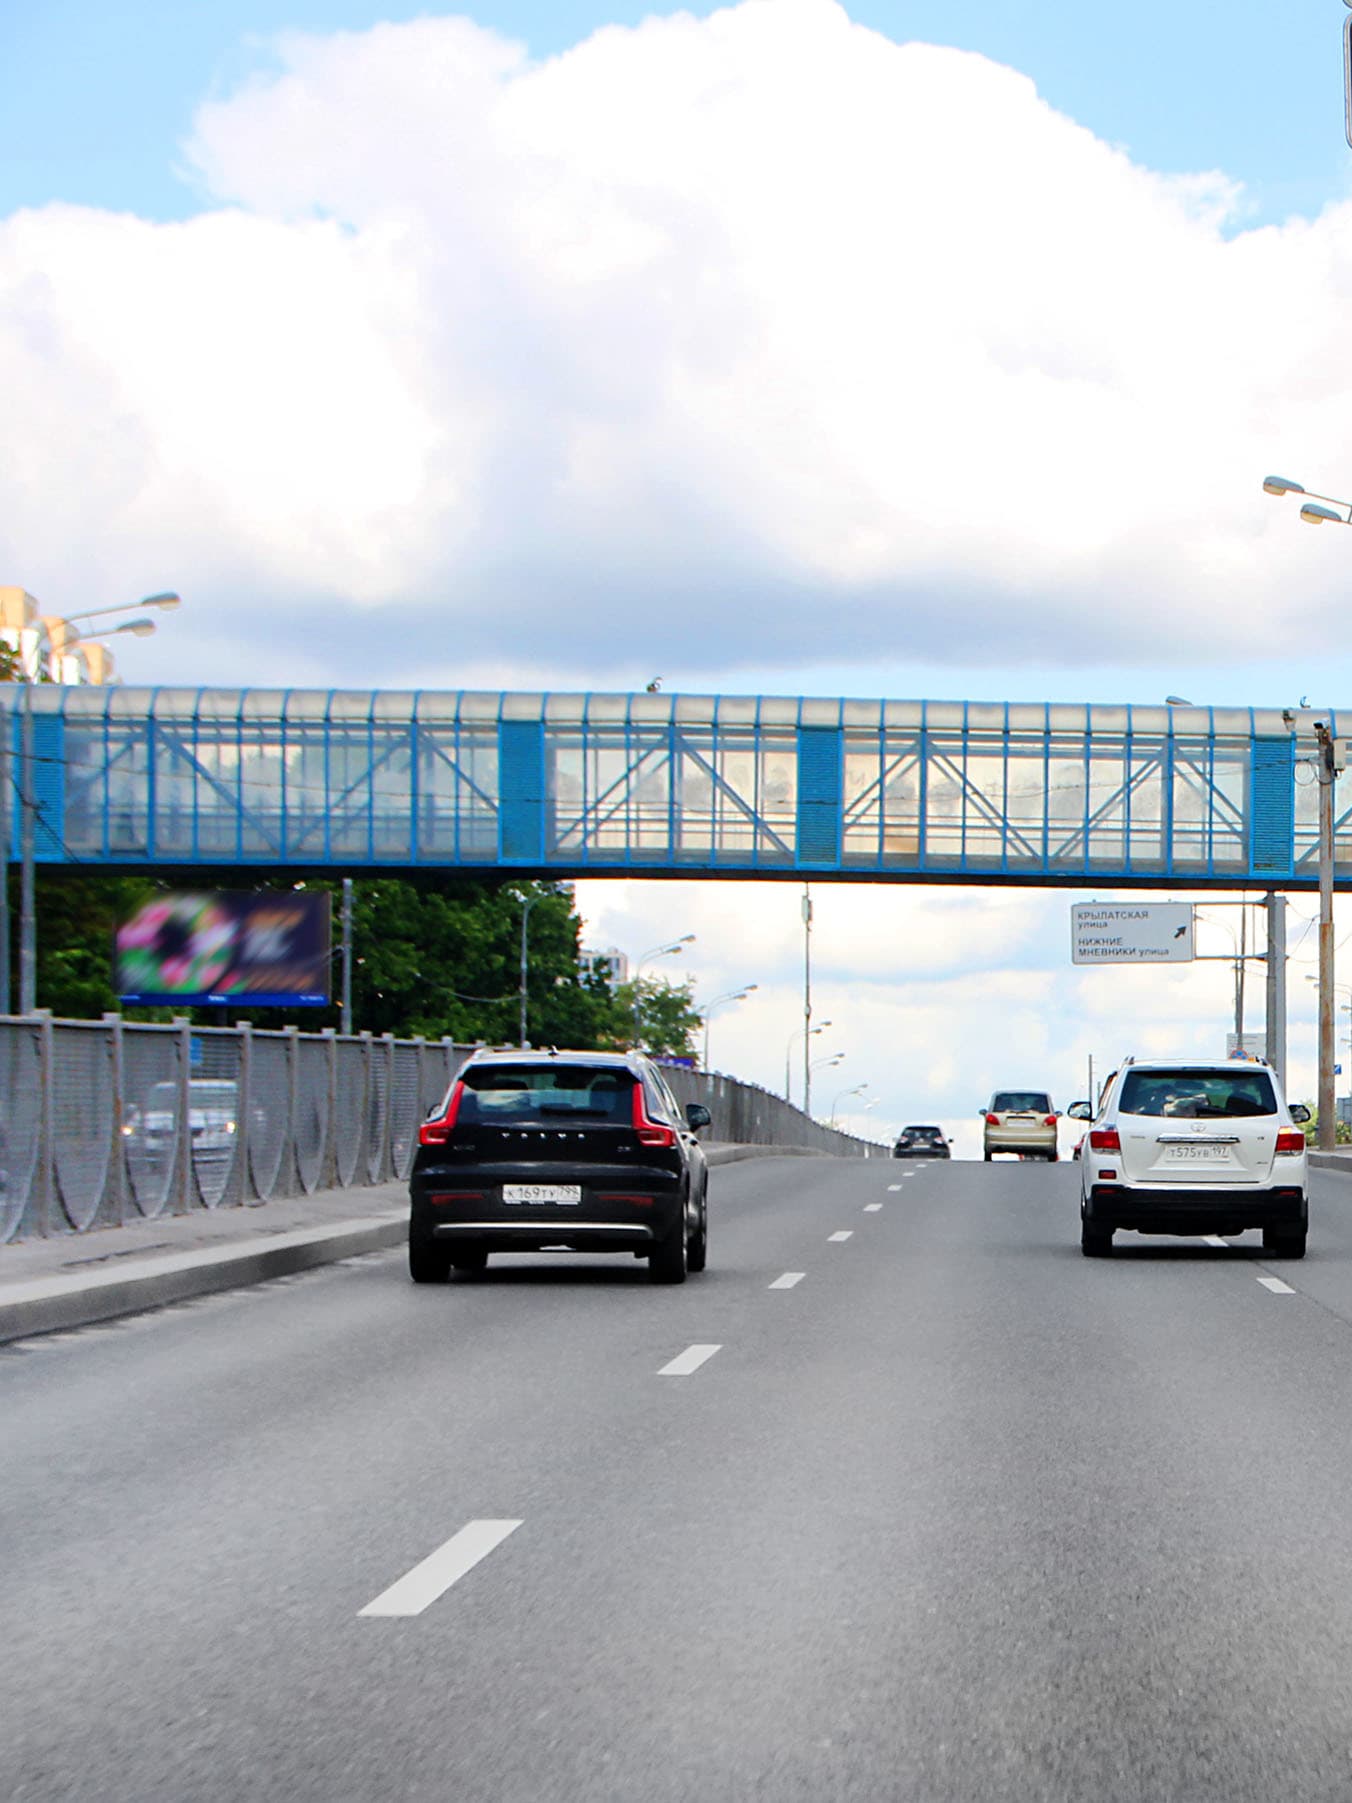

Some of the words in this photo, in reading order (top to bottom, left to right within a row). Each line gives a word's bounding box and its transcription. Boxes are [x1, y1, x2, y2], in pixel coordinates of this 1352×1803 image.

[1077, 911, 1149, 920] КРЫЛАТСКАЯ
[1078, 922, 1108, 930] улица
[1078, 937, 1123, 946] НИЖНИЕ
[1078, 948, 1136, 957] МНЕВНИКИ
[1138, 949, 1169, 957] улица
